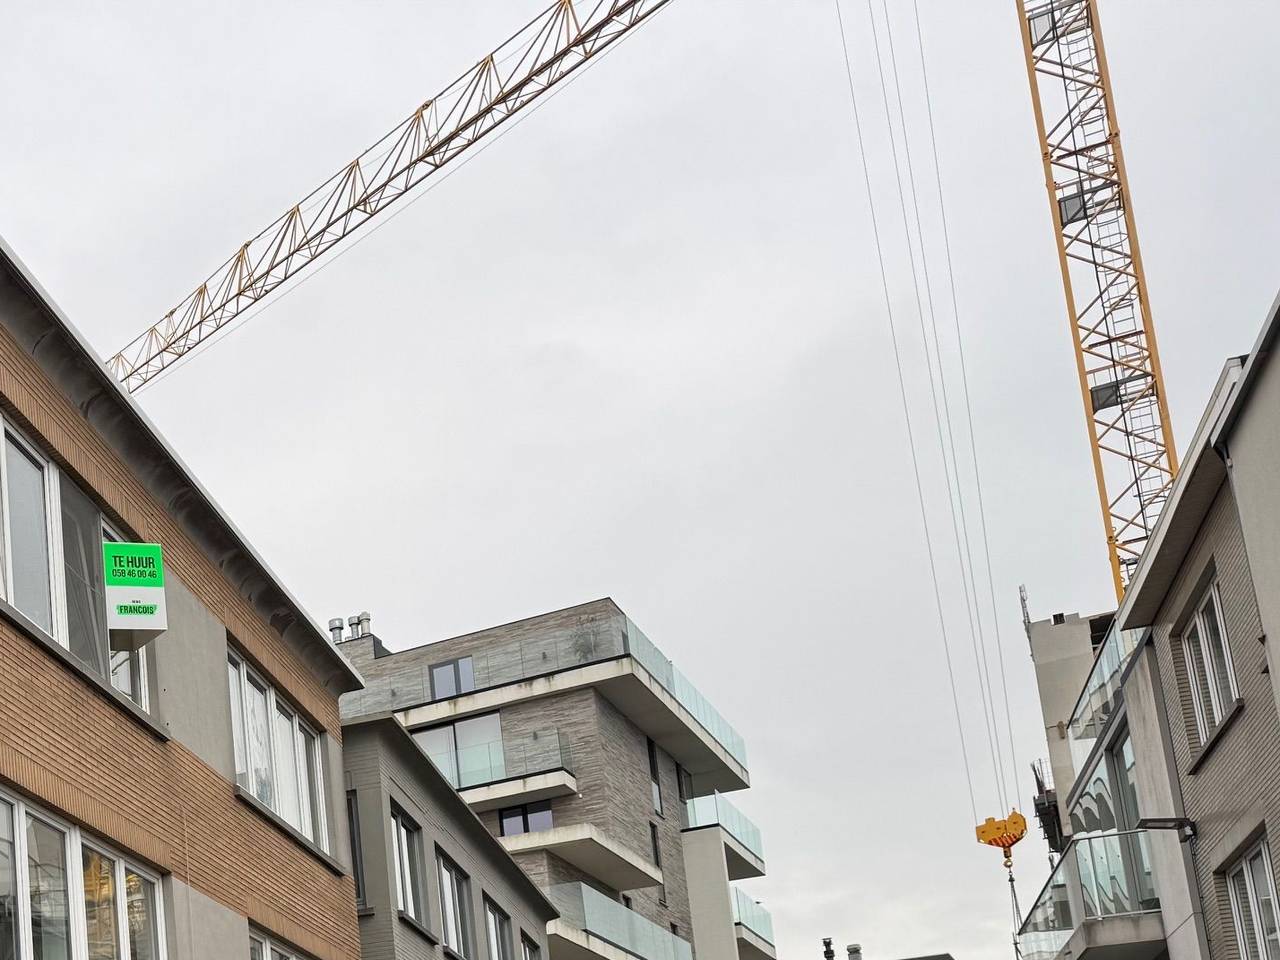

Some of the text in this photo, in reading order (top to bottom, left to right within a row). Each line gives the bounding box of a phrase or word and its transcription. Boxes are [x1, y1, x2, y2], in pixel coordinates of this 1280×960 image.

[112, 555, 155, 569] TE HUUR
[112, 569, 157, 579] 058 46 00 46
